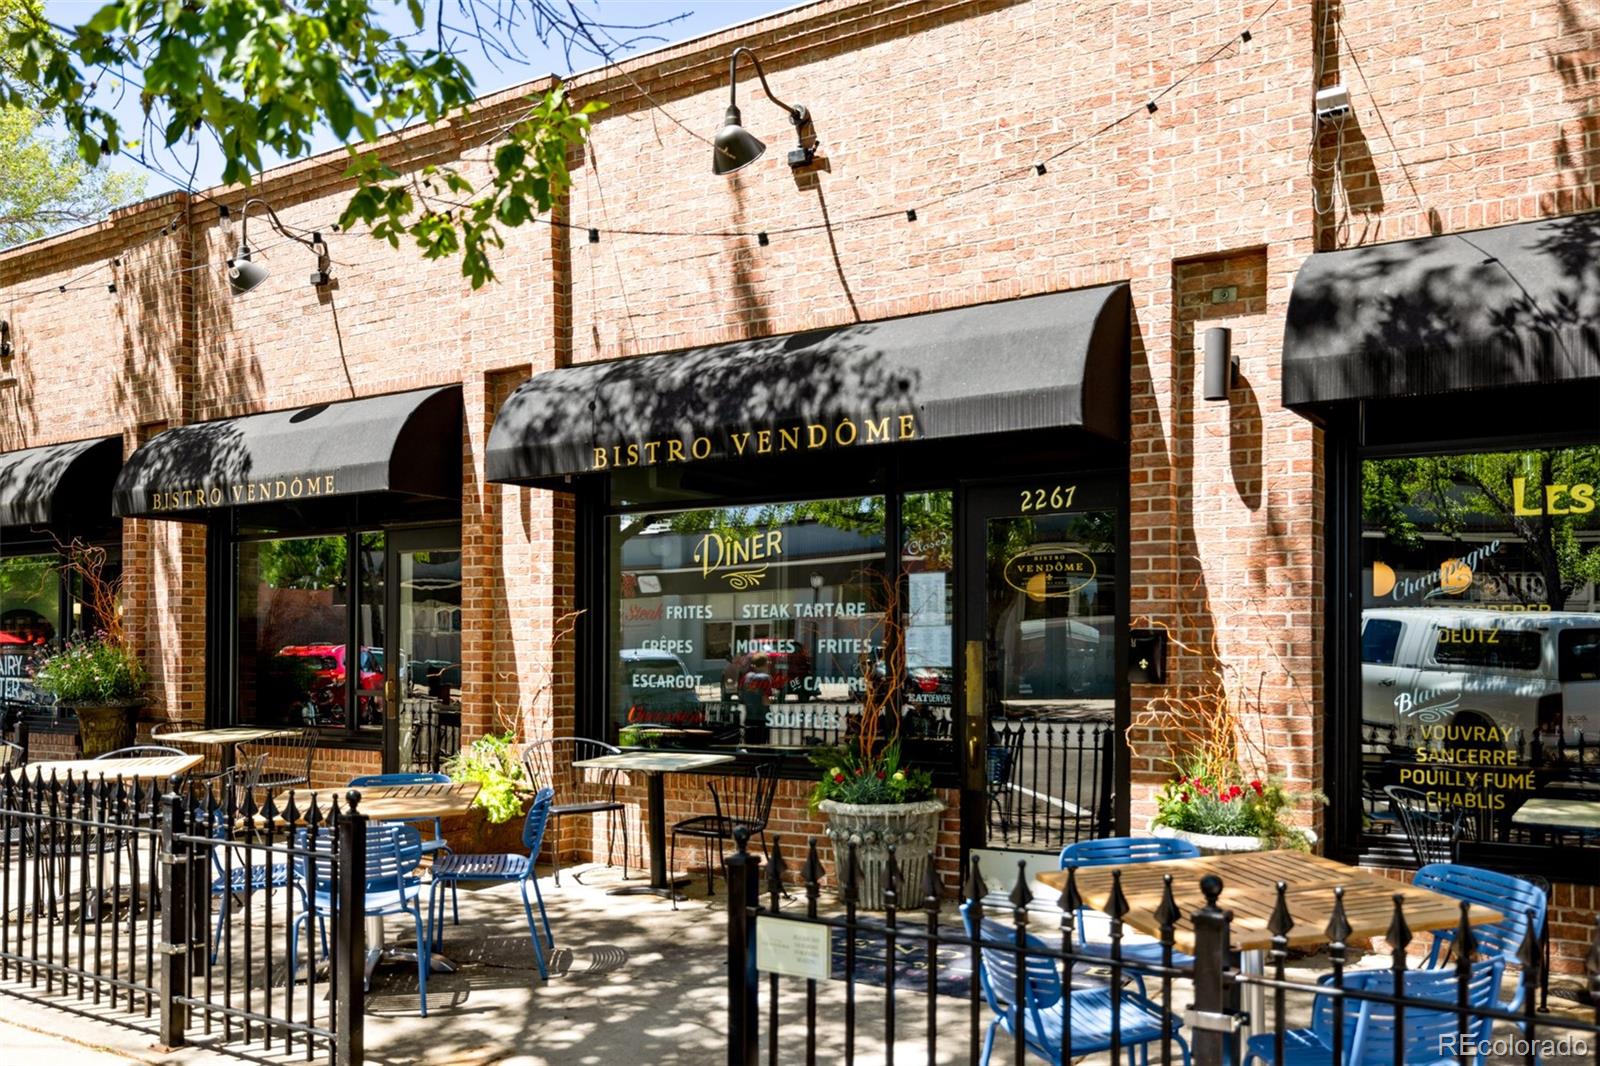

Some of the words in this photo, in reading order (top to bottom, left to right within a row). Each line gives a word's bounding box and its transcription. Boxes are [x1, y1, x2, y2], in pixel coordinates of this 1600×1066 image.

[593, 437, 711, 469] BISTRO
[731, 414, 916, 456] VENDÔME
[152, 487, 222, 510] BISTRO
[232, 475, 335, 502] VENDÔME
[1020, 485, 1077, 512] 2267
[1512, 476, 1597, 517] LES
[693, 530, 784, 580] DÎNER
[1391, 538, 1501, 601] Champagne
[666, 604, 713, 619] FRITES
[742, 603, 790, 619] STEAK
[793, 602, 866, 618] TARTARE
[642, 635, 693, 654] CRÊPES
[1438, 627, 1500, 644] DEUTZ
[818, 638, 872, 654] FRITES
[632, 674, 703, 689] ESCARGOT
[1420, 724, 1514, 743] VOUVRAY
[1416, 747, 1518, 766] SANCERRE
[1400, 768, 1478, 789] POUILLY
[1483, 769, 1537, 791] FUMÉ
[1425, 790, 1506, 811] CHABLIS
